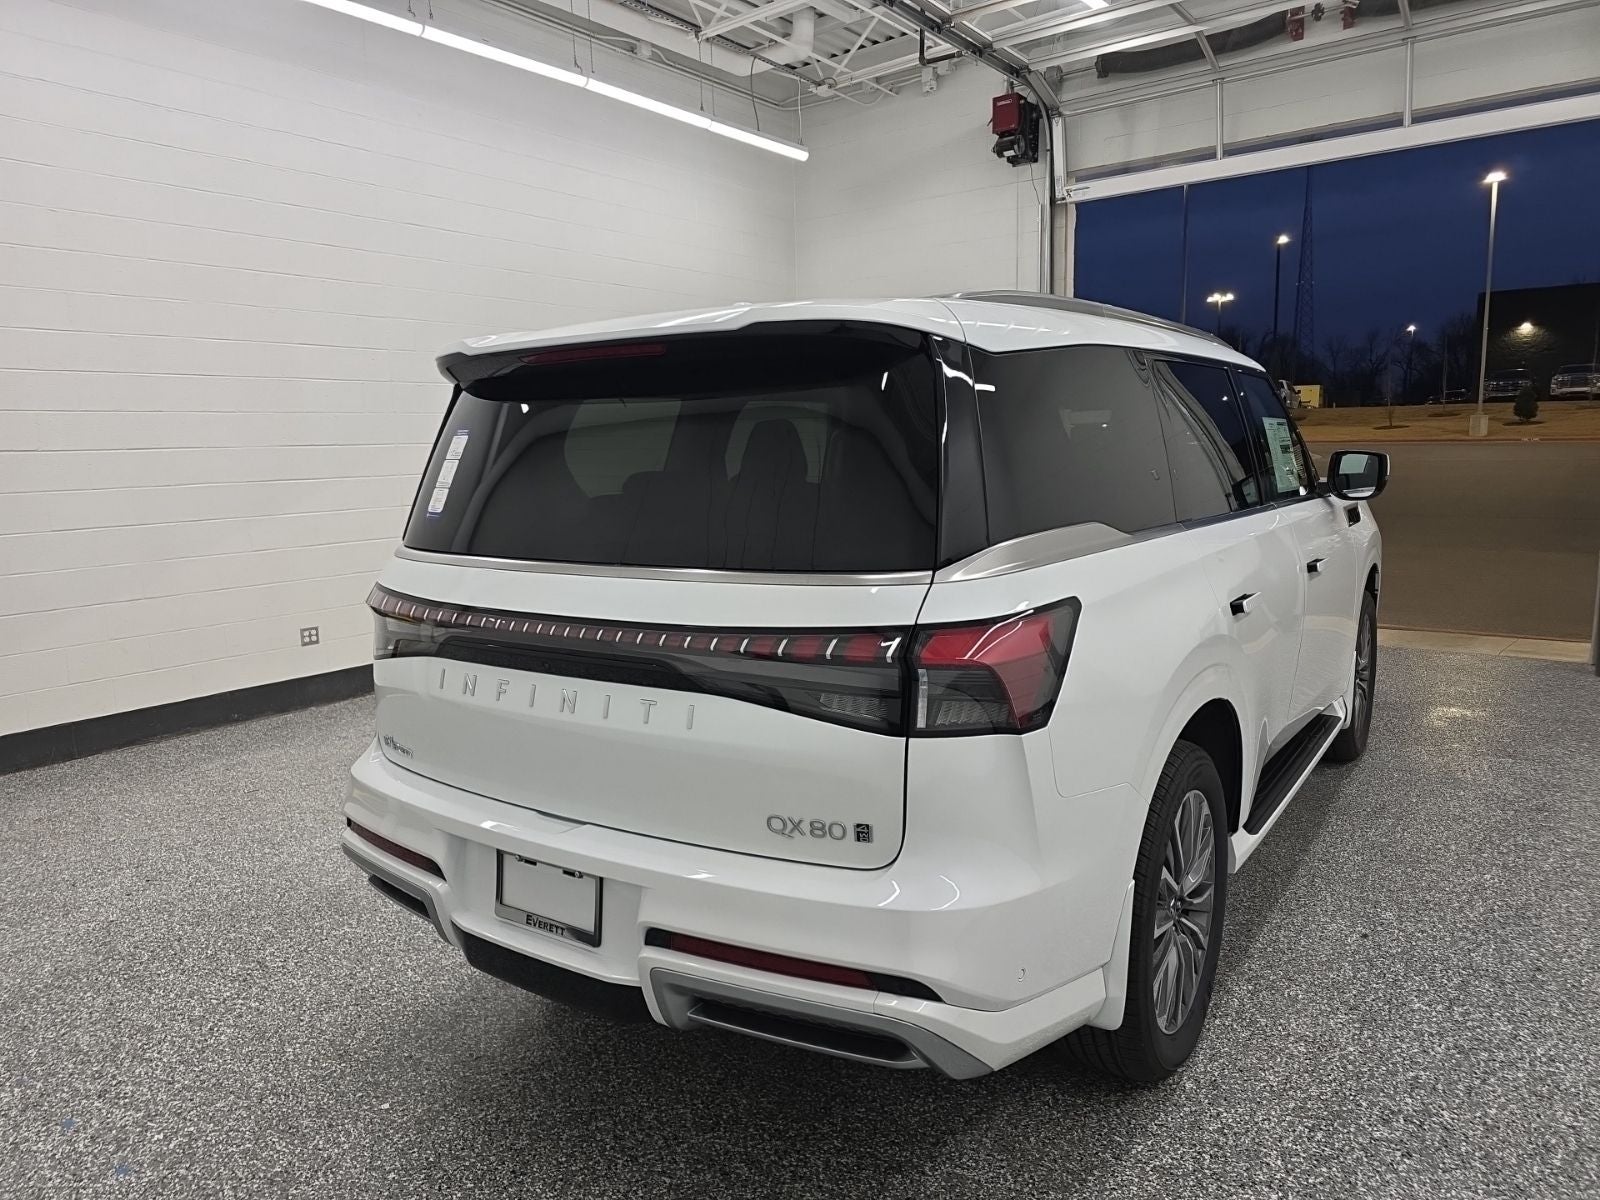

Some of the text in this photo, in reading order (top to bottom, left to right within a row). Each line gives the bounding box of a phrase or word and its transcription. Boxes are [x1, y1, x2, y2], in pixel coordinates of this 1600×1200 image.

[439, 668, 695, 730] INFINITI
[766, 814, 847, 841] QX80
[525, 914, 566, 936] EVERETT
